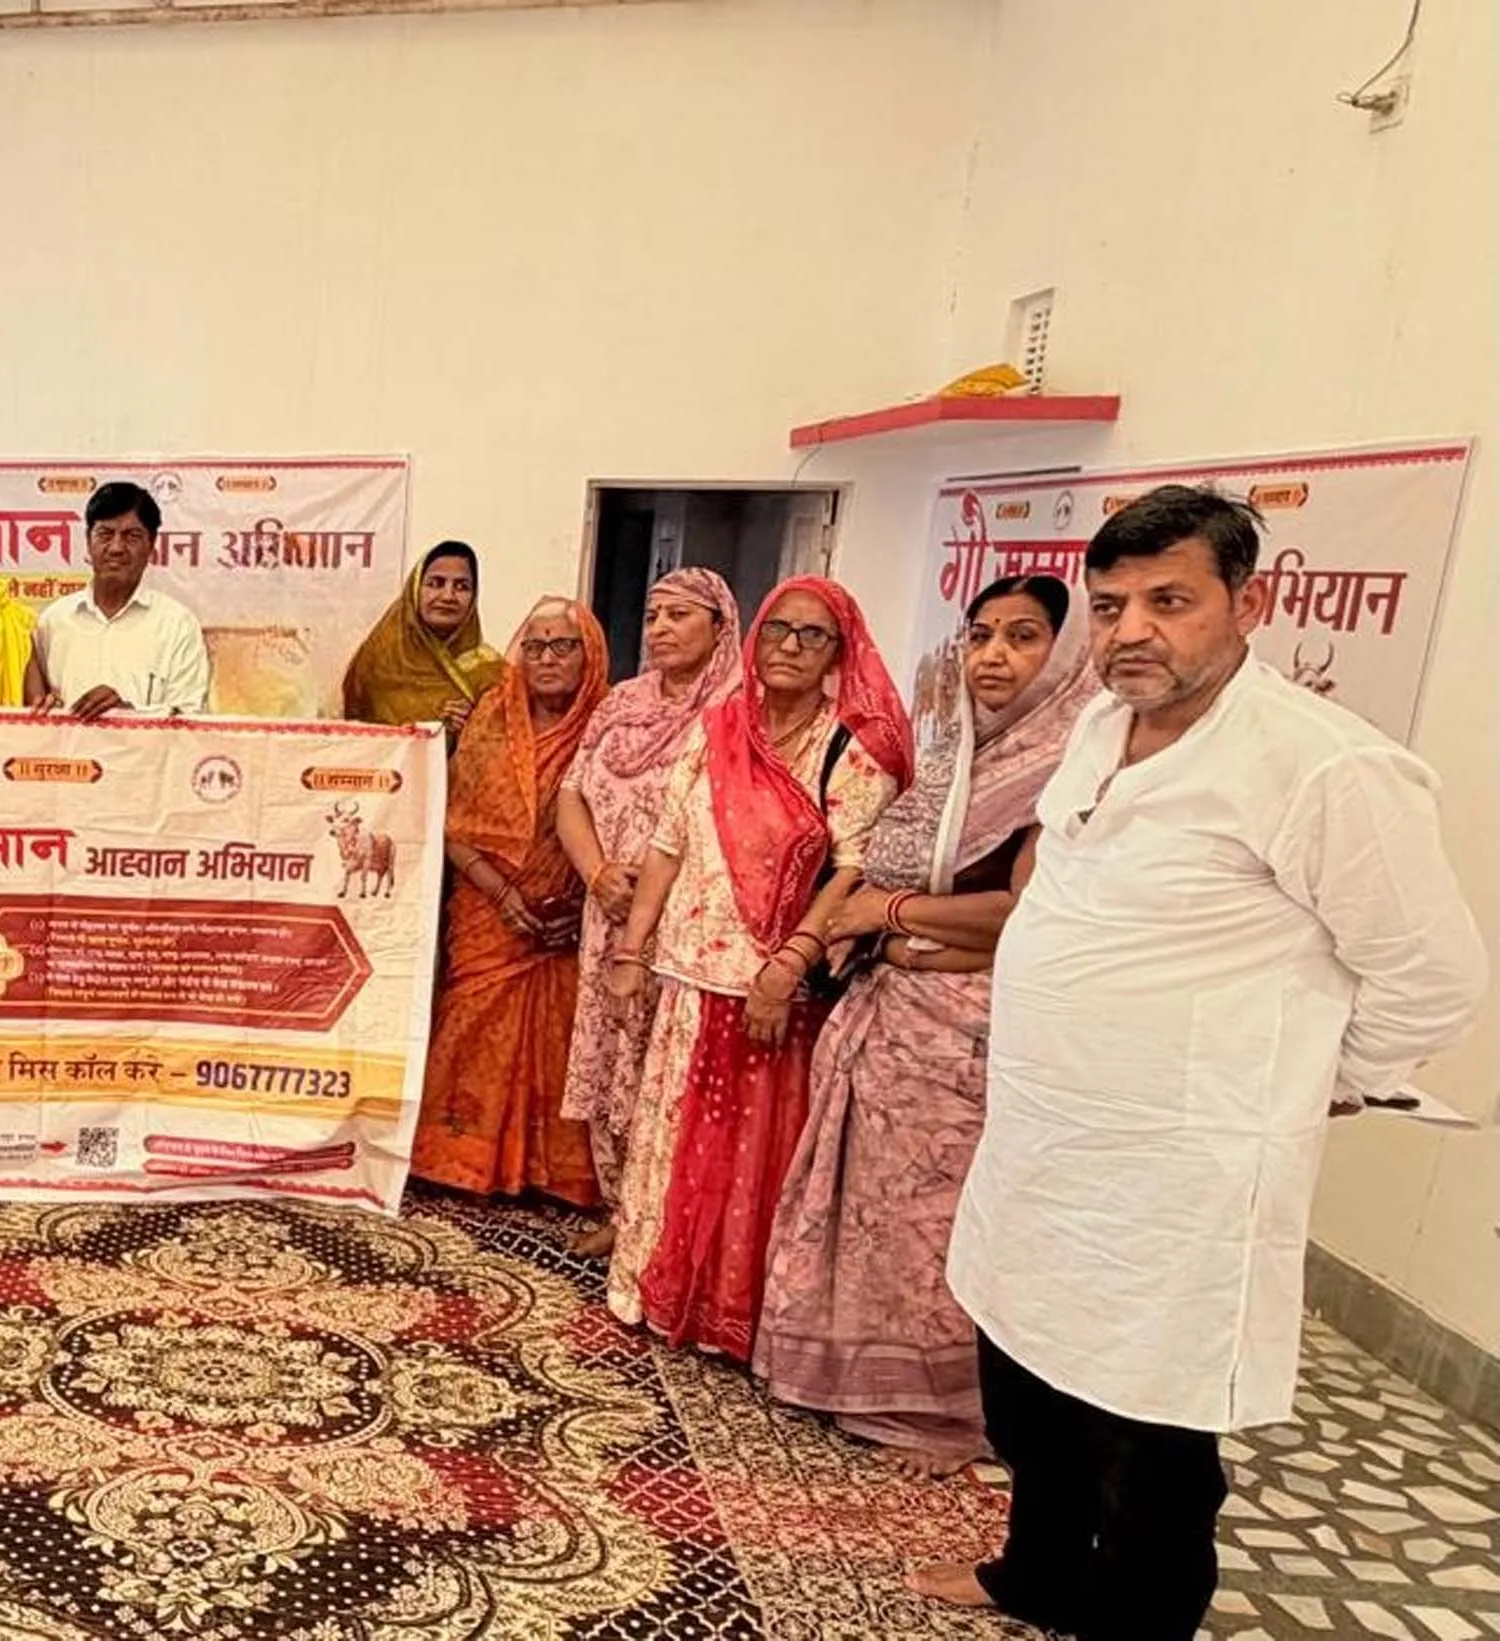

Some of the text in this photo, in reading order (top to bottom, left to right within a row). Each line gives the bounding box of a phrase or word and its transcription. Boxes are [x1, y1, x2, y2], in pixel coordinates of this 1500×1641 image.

[1257, 548, 1408, 635] भियान
[197, 842, 314, 883] अभियान
[8, 1050, 58, 1080] मिस
[64, 1053, 117, 1080] कॉल
[196, 1060, 351, 1098] 9067777323
